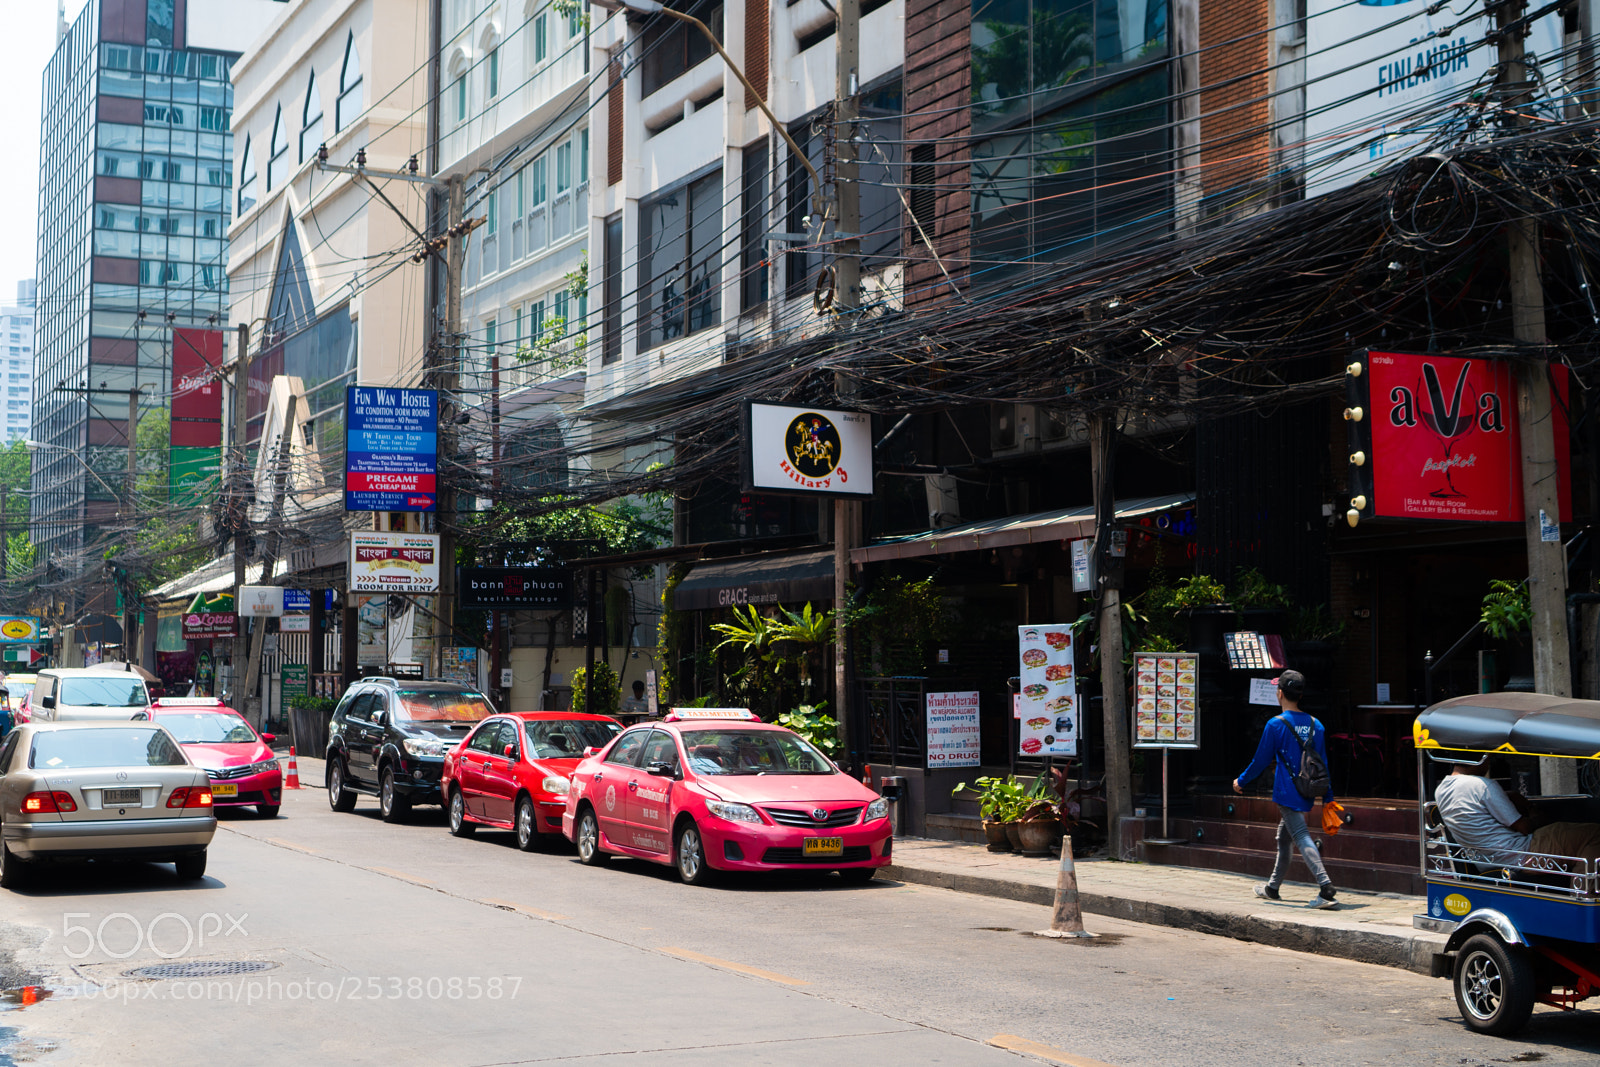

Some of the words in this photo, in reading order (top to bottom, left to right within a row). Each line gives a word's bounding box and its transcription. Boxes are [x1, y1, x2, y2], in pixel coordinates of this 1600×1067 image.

[1378, 36, 1469, 98] FINLANDIA
[355, 406, 365, 415] AIR
[365, 407, 394, 416] CONDITION
[395, 408, 411, 417] DORM
[412, 408, 430, 417] ROOMS
[366, 474, 419, 483] PREGAME
[779, 459, 831, 488] Hillary
[836, 466, 848, 483] 3
[375, 483, 400, 491] CHEAP
[353, 491, 379, 499] LAUNDRY
[358, 547, 388, 559] বাংলা
[402, 549, 432, 560] খাবার
[357, 583, 384, 591] ROOM
[471, 579, 504, 589] bann
[523, 580, 563, 591] phuan
[718, 588, 748, 605] GRACE
[199, 613, 235, 626] Lotus
[928, 693, 978, 707] ห้ามค้าประเวณี
[948, 752, 979, 760] DRUG
[820, 839, 840, 848] 9436
